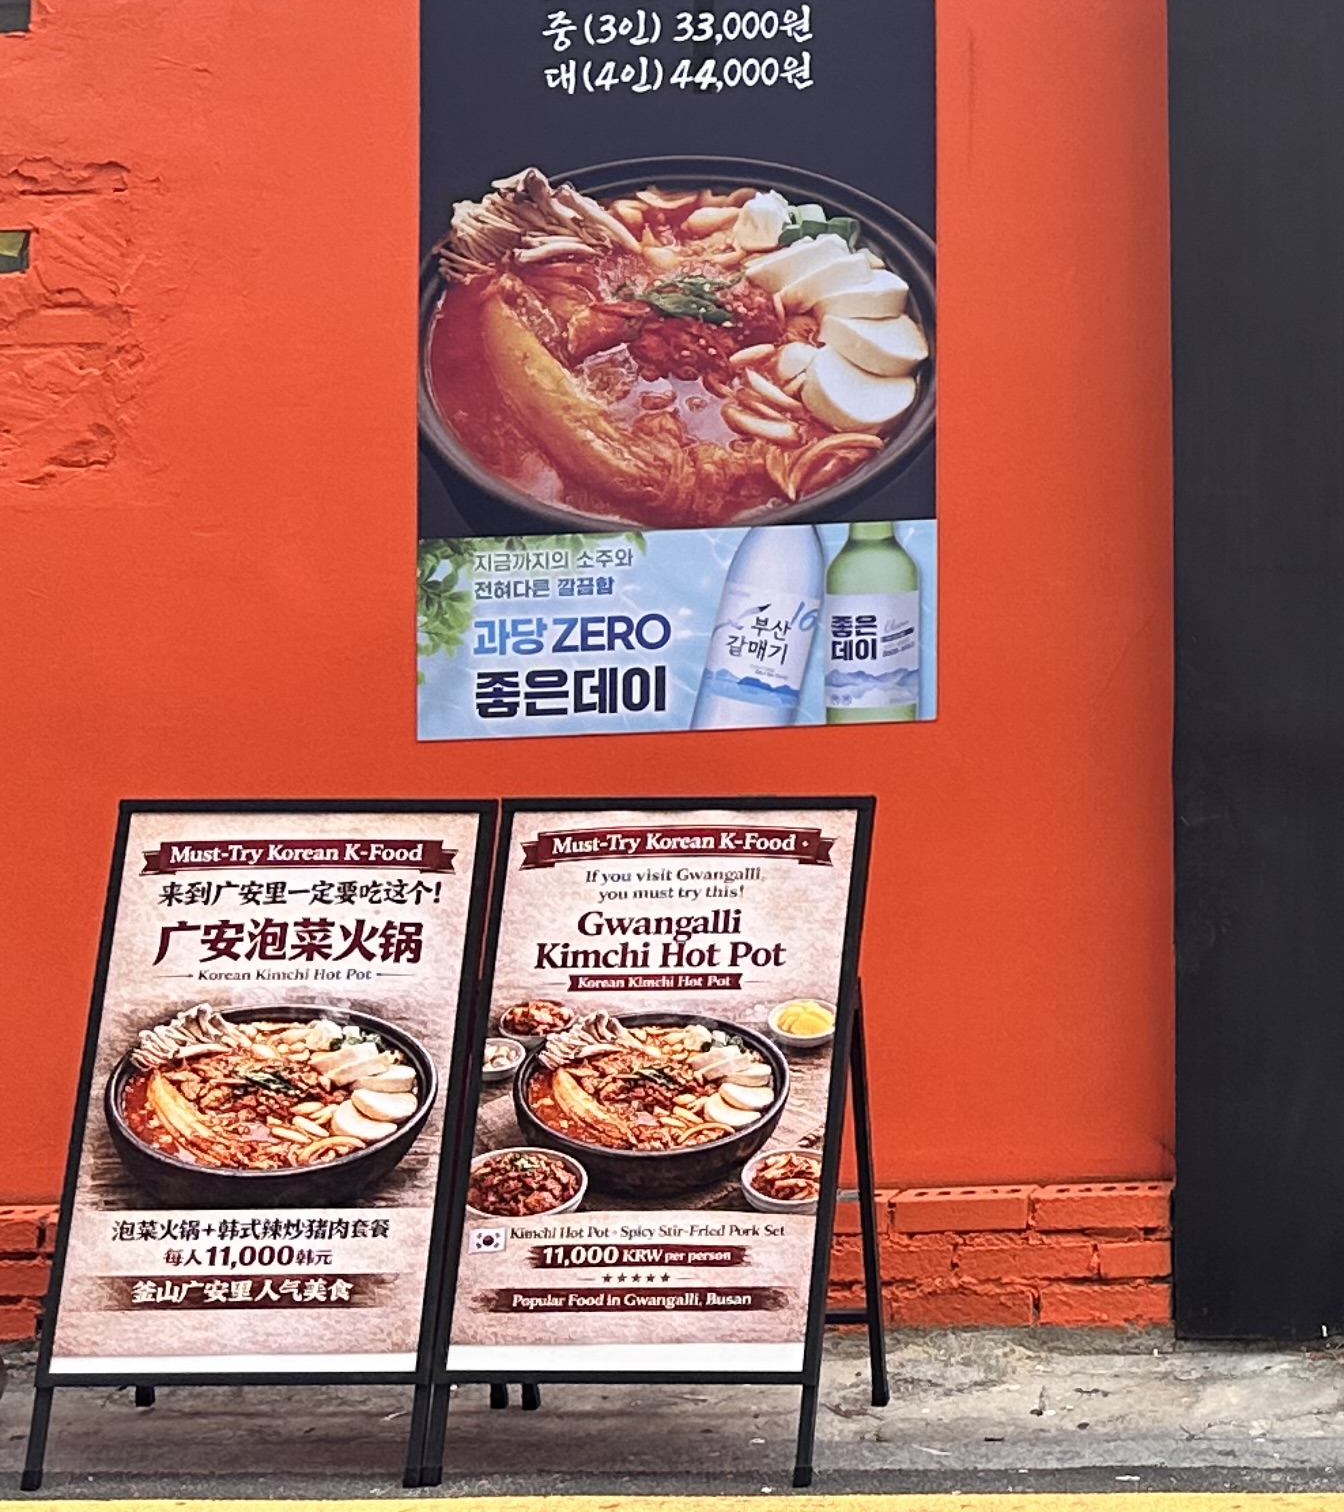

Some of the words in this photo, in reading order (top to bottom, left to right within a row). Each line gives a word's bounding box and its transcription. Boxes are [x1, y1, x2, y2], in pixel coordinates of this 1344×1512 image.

[673, 4, 813, 45] 33,000원
[670, 52, 814, 92] 44,000원
[474, 551, 569, 572] 지금까지의
[576, 548, 633, 568] 소주와
[557, 576, 616, 596] 깔끔함
[552, 613, 671, 654] ZERO
[751, 616, 791, 641] 부산
[831, 615, 878, 638] 좋은
[726, 634, 788, 665] 갈매기
[831, 638, 877, 661] 데이
[475, 665, 666, 719] 좋은데이
[170, 844, 263, 865] Must-Try
[267, 844, 338, 862] Korean
[344, 844, 423, 861] K-Food
[552, 835, 641, 854] Must-Try
[646, 834, 714, 850] Korean
[719, 833, 796, 850] K-Food
[585, 869, 600, 883] If
[601, 872, 631, 885] you
[637, 869, 672, 882] visit
[158, 879, 441, 907] 来到广安里一定要吃这个!
[598, 889, 628, 903] you
[633, 887, 673, 899] must
[678, 887, 702, 901] try
[706, 885, 745, 898] this!
[578, 909, 742, 942] Gwangalli
[153, 918, 423, 966] 广安泡菜火锅
[534, 942, 650, 969] Kimchi
[659, 941, 720, 968] Hot
[728, 941, 786, 968] Pot
[198, 969, 251, 981] Korean
[256, 968, 309, 981] Kimchi
[314, 969, 341, 980] Hot
[346, 968, 372, 980] Pot
[578, 977, 625, 989] Korean
[628, 976, 674, 988] Kimchi
[678, 976, 703, 987] Hot
[707, 976, 731, 987] Pot
[560, 1227, 583, 1238] Hot
[588, 1227, 610, 1238] Pot
[620, 1226, 655, 1240] Spicy
[729, 1225, 760, 1237] Pork
[763, 1225, 785, 1237] Set
[543, 1247, 619, 1266] 11,000
[623, 1250, 662, 1263] KRW
[664, 1252, 685, 1265] per
[688, 1251, 732, 1264] person
[131, 1279, 354, 1304] 釜山广安里人气美食
[512, 1294, 566, 1309] Popular
[568, 1294, 604, 1307] Food
[607, 1294, 620, 1306] in
[705, 1292, 752, 1305] Busan
